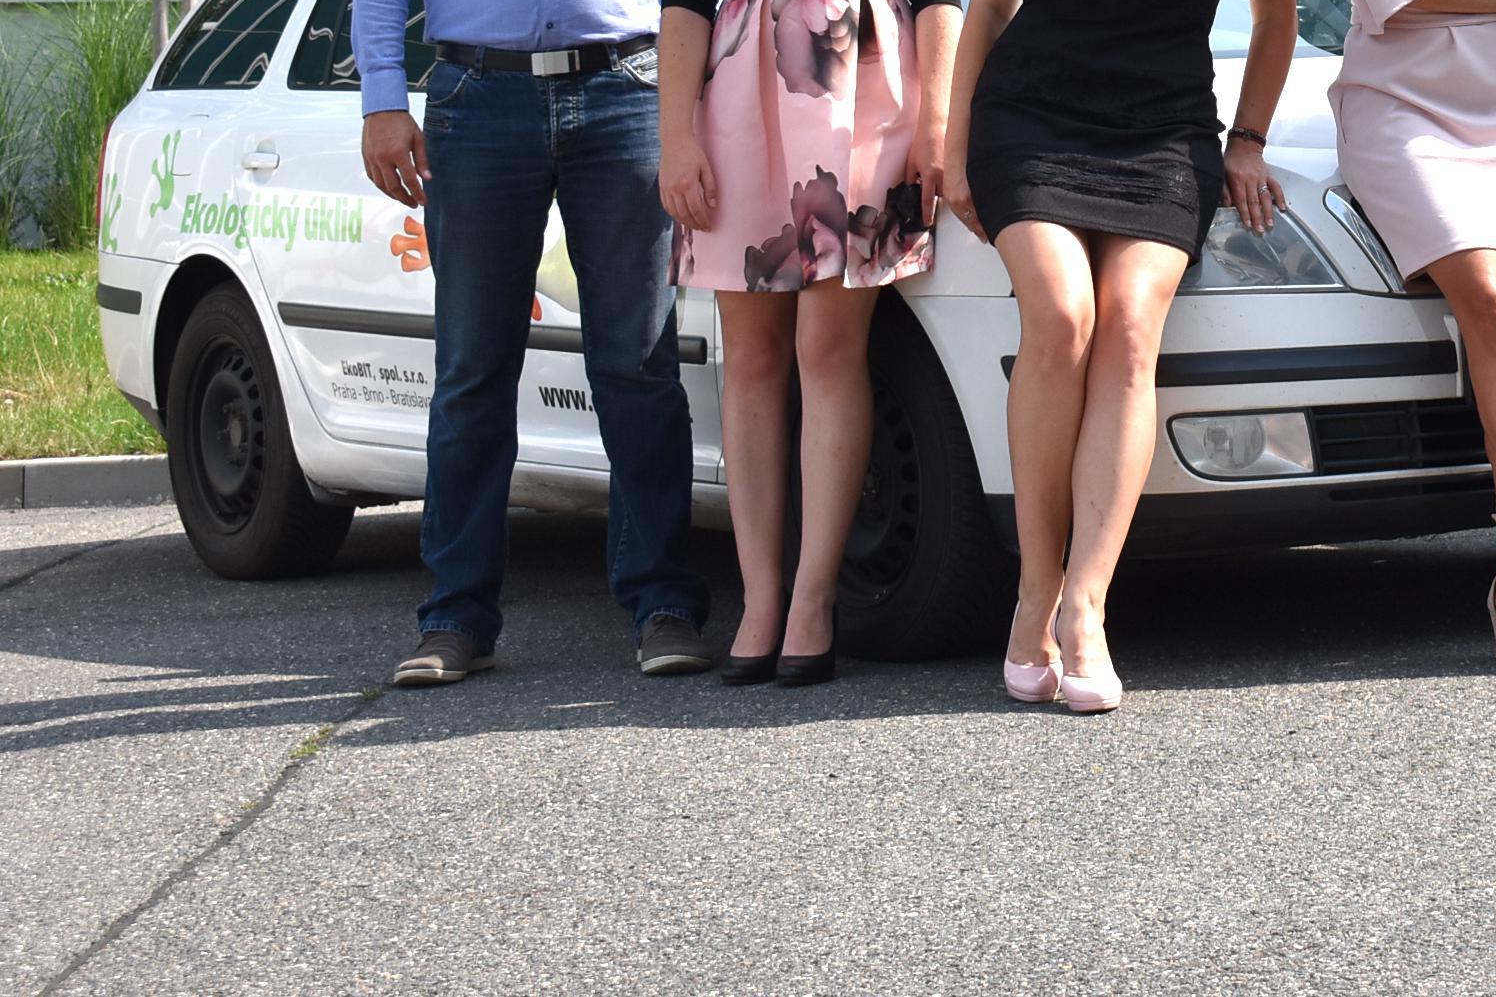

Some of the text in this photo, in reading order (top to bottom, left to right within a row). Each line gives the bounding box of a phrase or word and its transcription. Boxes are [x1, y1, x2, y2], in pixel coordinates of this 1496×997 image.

[180, 193, 363, 252] Ekologický úklid
[341, 360, 428, 385] EkoBIT, spol. s.r.o.
[331, 382, 357, 400] Praha
[362, 386, 385, 404] Brno
[538, 385, 593, 412] www.
